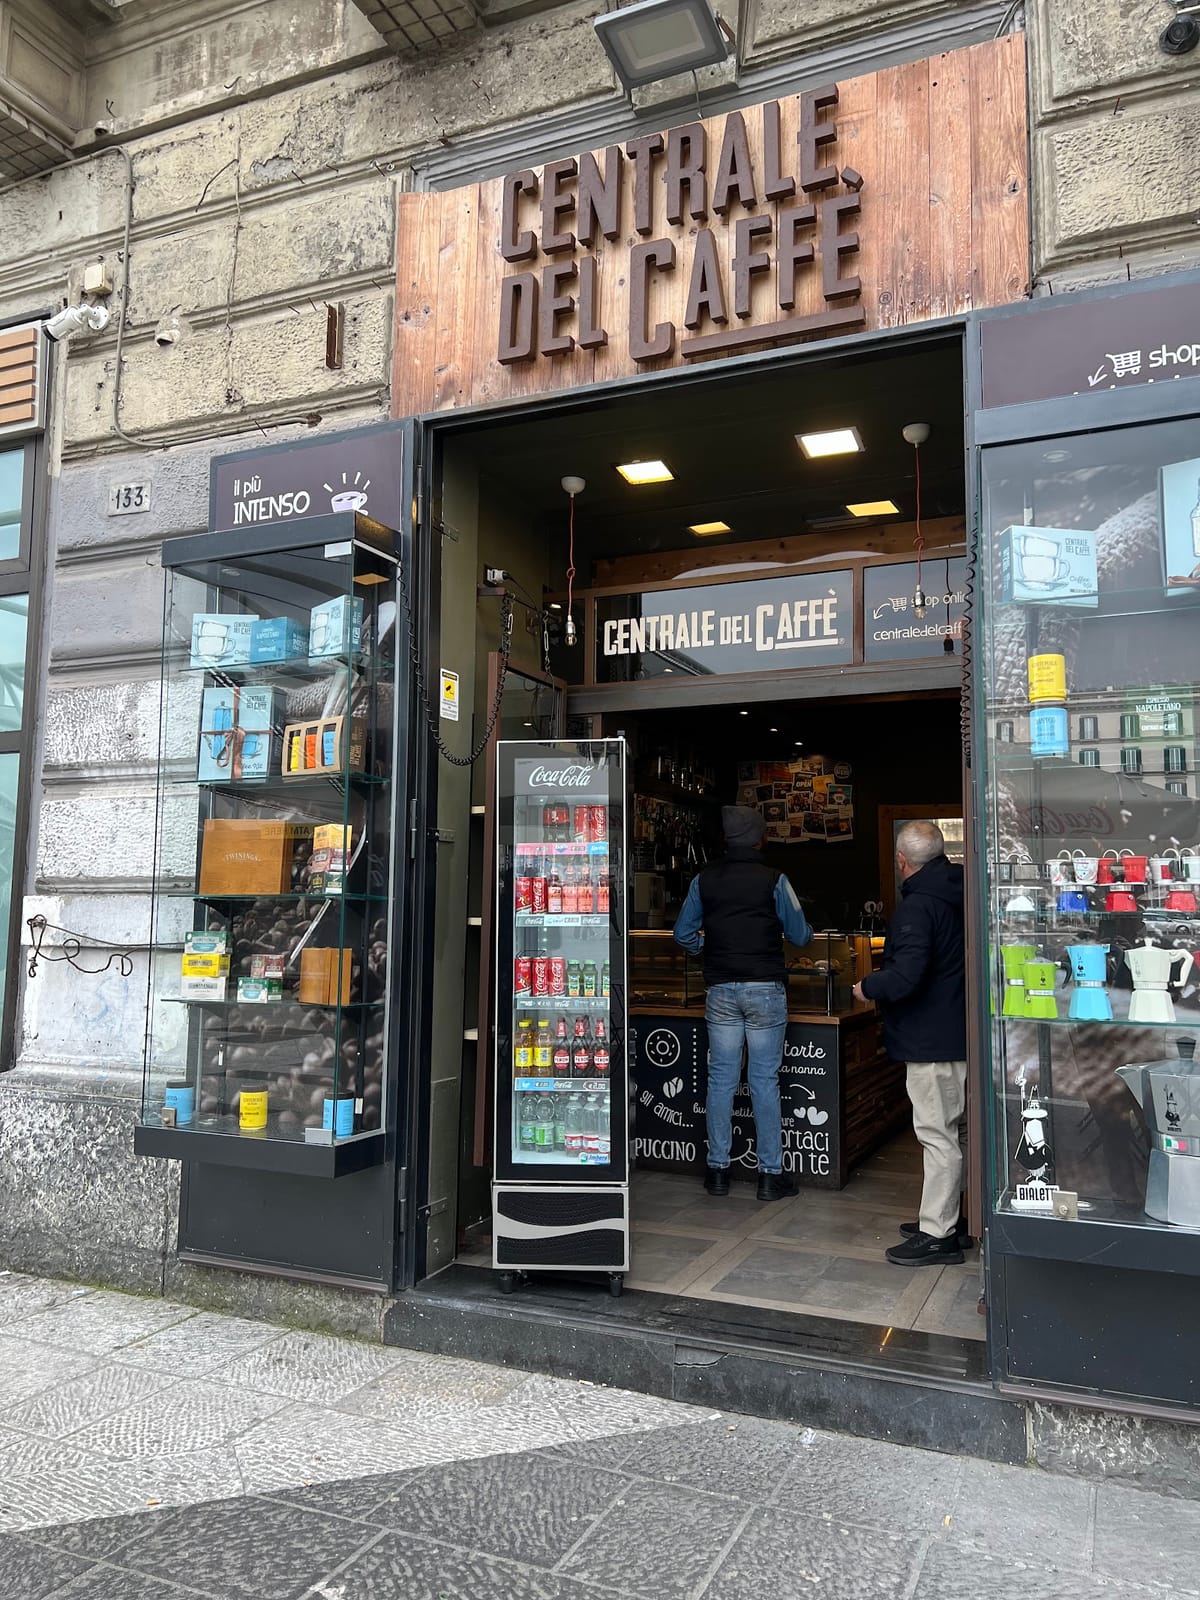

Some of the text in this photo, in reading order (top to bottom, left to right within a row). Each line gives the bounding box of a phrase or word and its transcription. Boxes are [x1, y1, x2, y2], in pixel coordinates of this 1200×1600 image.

[501, 83, 840, 263] CENTRALE
[497, 165, 864, 366] DEL CAFFÈ
[1149, 344, 1200, 368] shop
[114, 485, 144, 510] 133
[233, 490, 311, 525] INTENSO
[910, 595, 939, 609] sop
[603, 587, 838, 656] CENTRALE DEL CAFFÈ
[784, 1040, 826, 1059] torte
[790, 1066, 826, 1076] nonna
[808, 1153, 830, 1175] te
